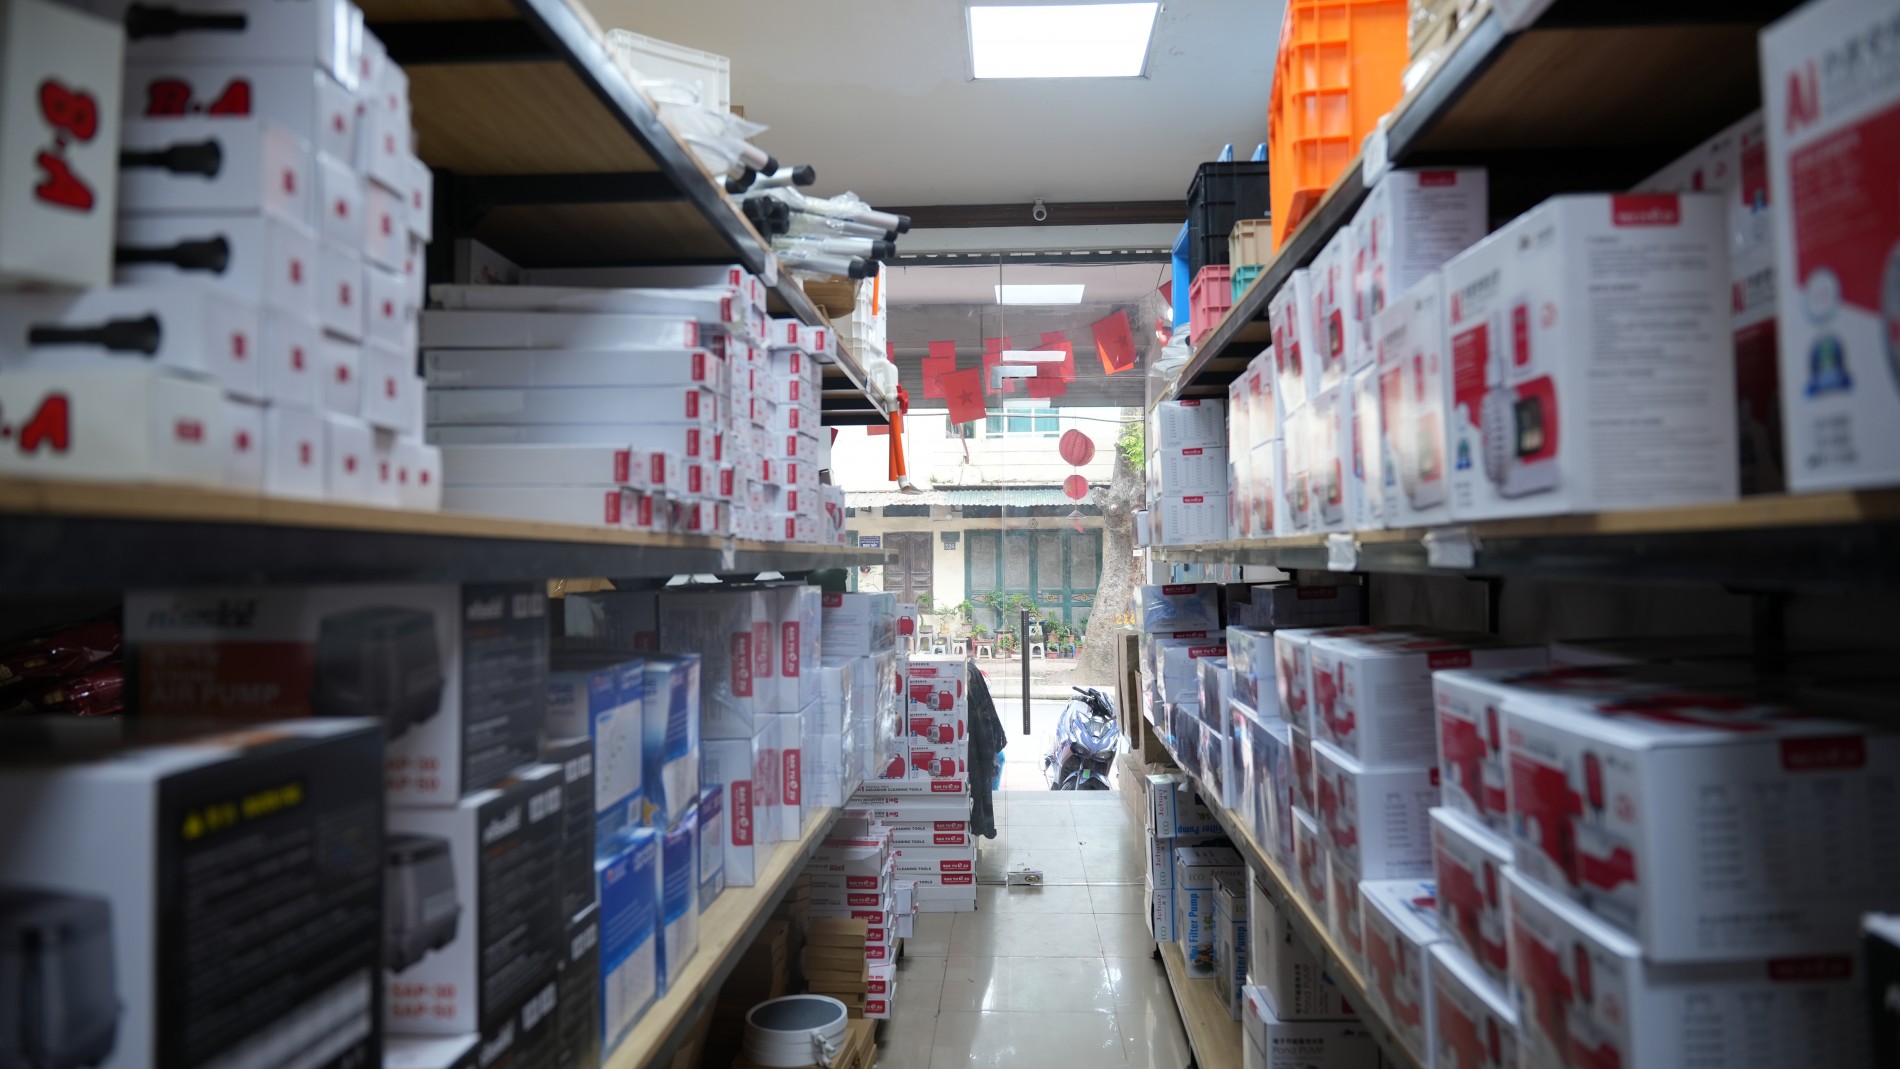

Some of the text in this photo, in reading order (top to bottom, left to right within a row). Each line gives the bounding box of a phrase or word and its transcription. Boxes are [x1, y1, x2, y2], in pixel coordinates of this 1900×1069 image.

[201, 683, 281, 705] PUMP
[1188, 893, 1199, 917] Pump
[1188, 919, 1198, 943] Filter
[1235, 926, 1247, 953] Pump
